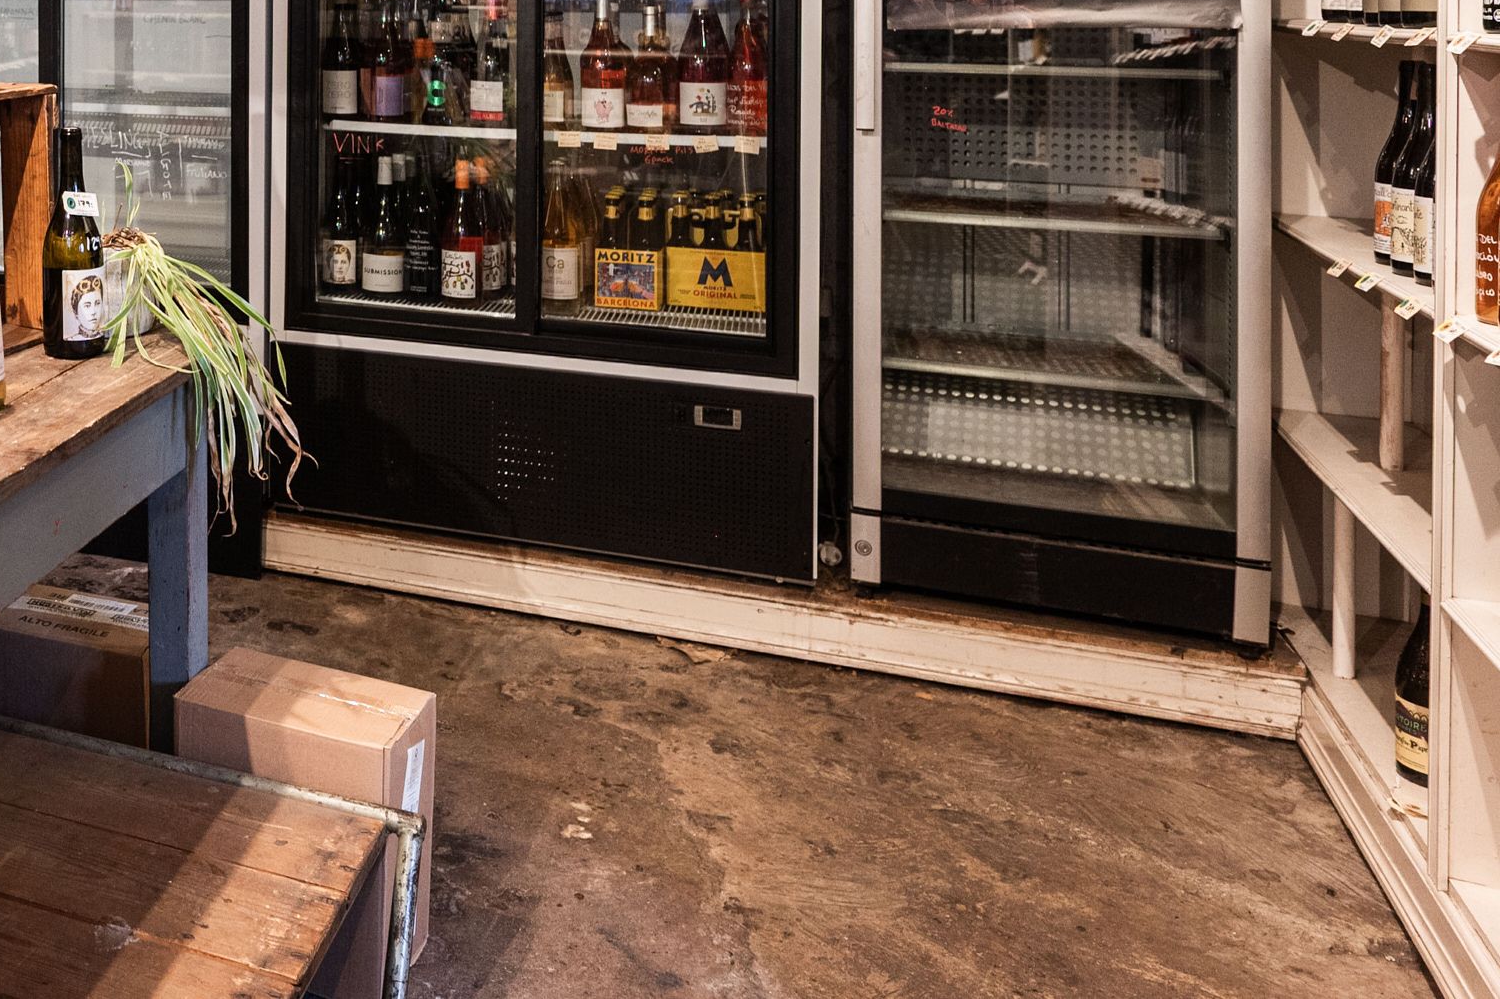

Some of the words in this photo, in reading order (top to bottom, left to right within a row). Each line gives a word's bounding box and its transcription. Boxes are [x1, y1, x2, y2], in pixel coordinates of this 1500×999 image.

[597, 251, 655, 264] MORITZ
[697, 256, 733, 287] M
[693, 289, 738, 300] ORIGINAL
[596, 297, 655, 309] BARCELONA
[18, 615, 53, 628] ALTO
[52, 622, 111, 639] FRAGILE
